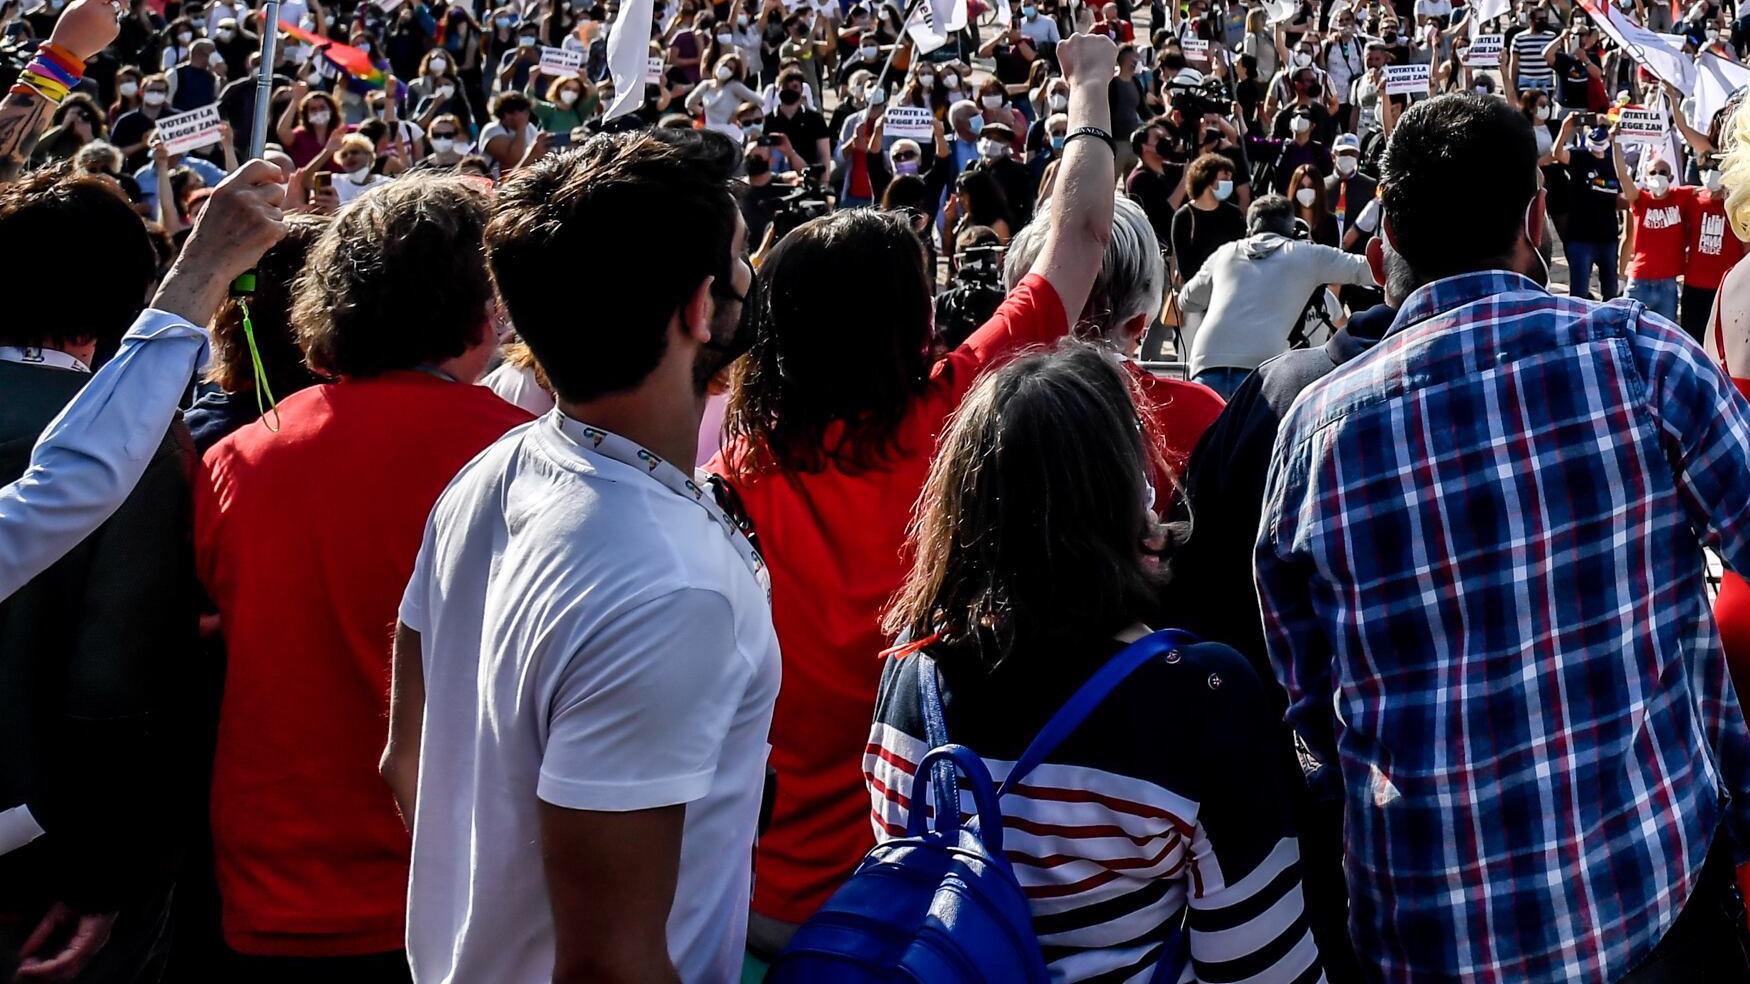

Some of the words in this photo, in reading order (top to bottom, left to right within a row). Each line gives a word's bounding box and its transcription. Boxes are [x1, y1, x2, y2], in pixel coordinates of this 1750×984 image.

[1388, 67, 1416, 75] VOTATE
[1387, 75, 1412, 83] LEGGE
[888, 109, 920, 118] VOTATE
[1623, 111, 1649, 120] OTATE
[160, 112, 200, 130] VOTATE
[200, 107, 214, 119] LA
[885, 117, 914, 125] LEGGE
[162, 126, 197, 141] LEGGE
[199, 119, 221, 132] ZAN
[1645, 122, 1663, 131] ZAN
